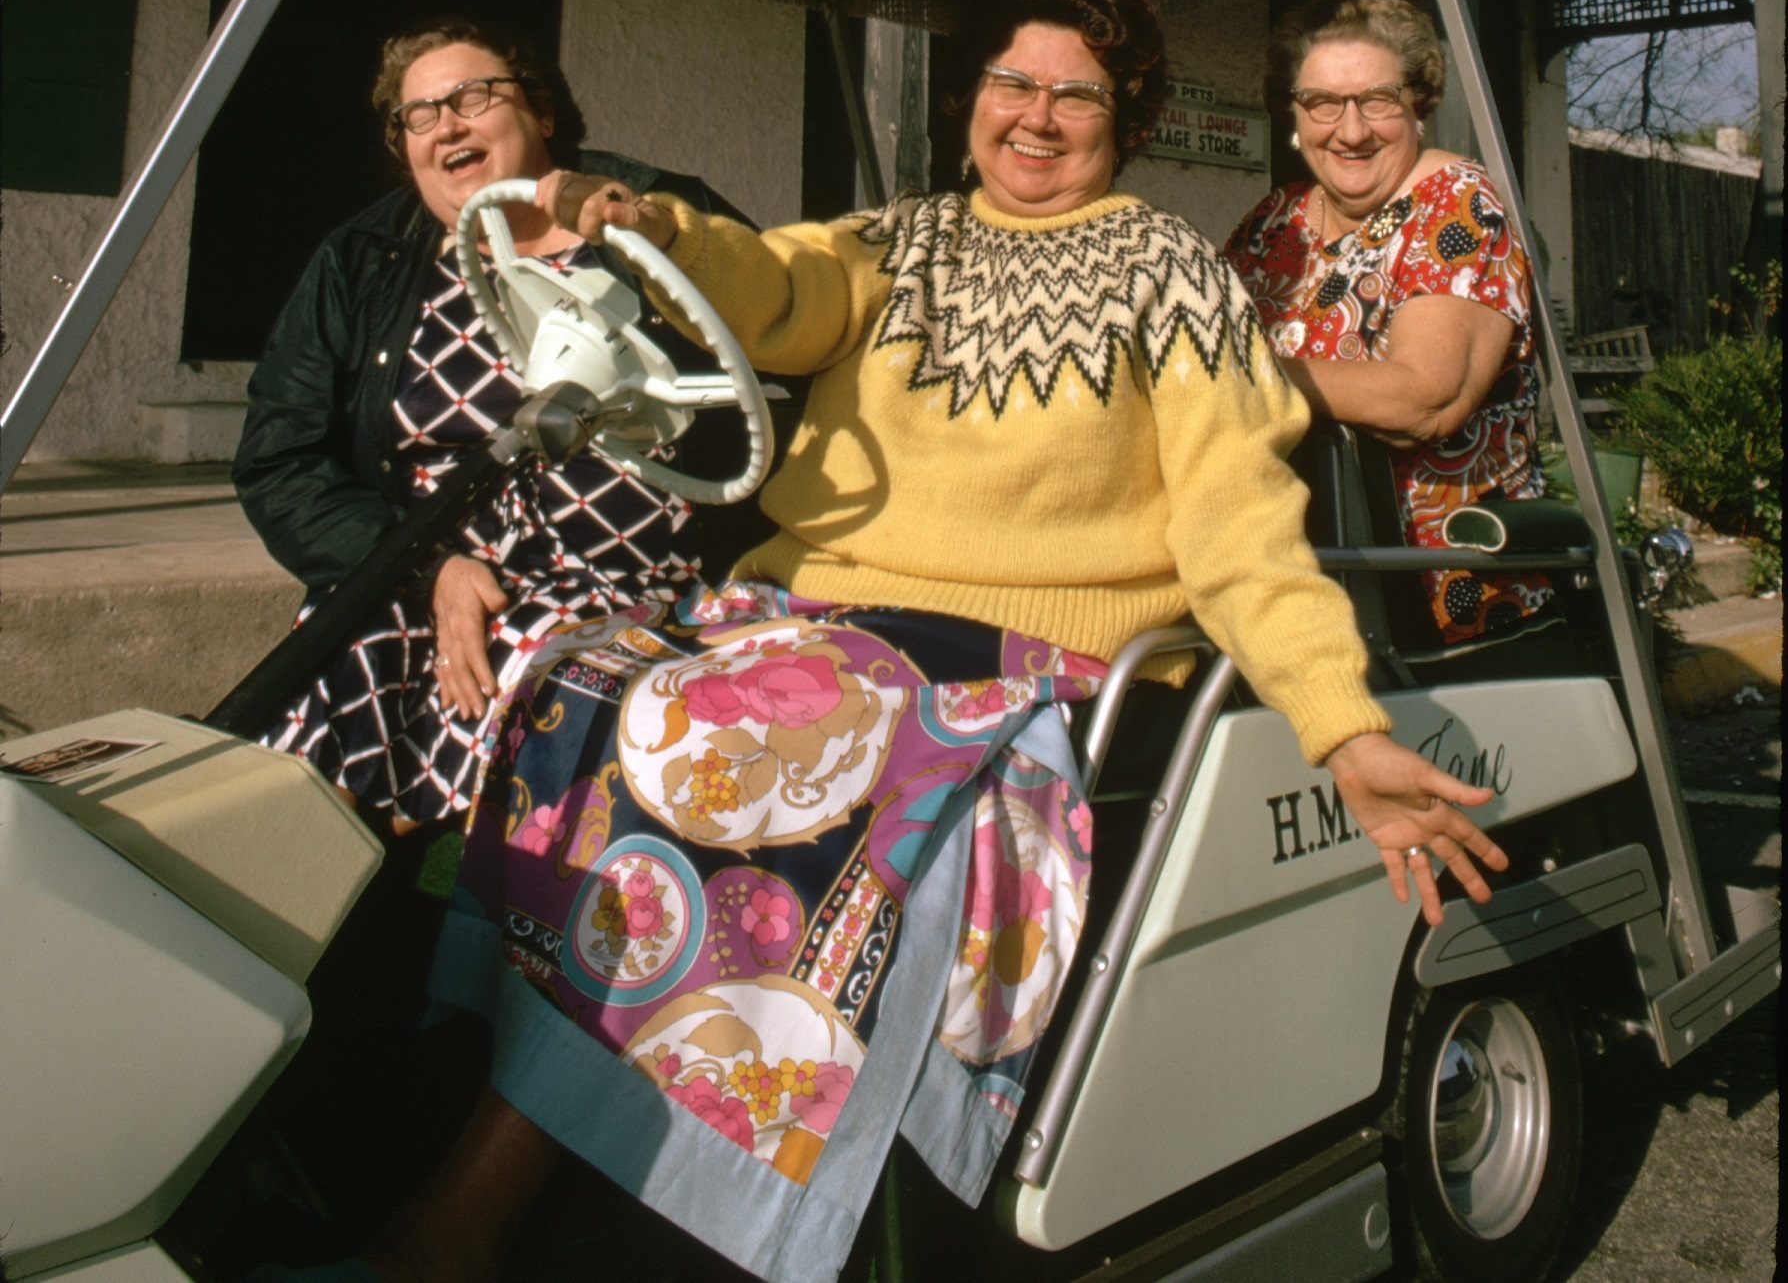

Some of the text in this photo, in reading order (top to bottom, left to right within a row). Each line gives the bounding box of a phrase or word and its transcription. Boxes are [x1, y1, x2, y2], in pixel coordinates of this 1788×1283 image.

[1181, 85, 1215, 103] PETS
[1159, 108, 1248, 137] TAIL LOUNGE
[1197, 133, 1241, 156] STORE
